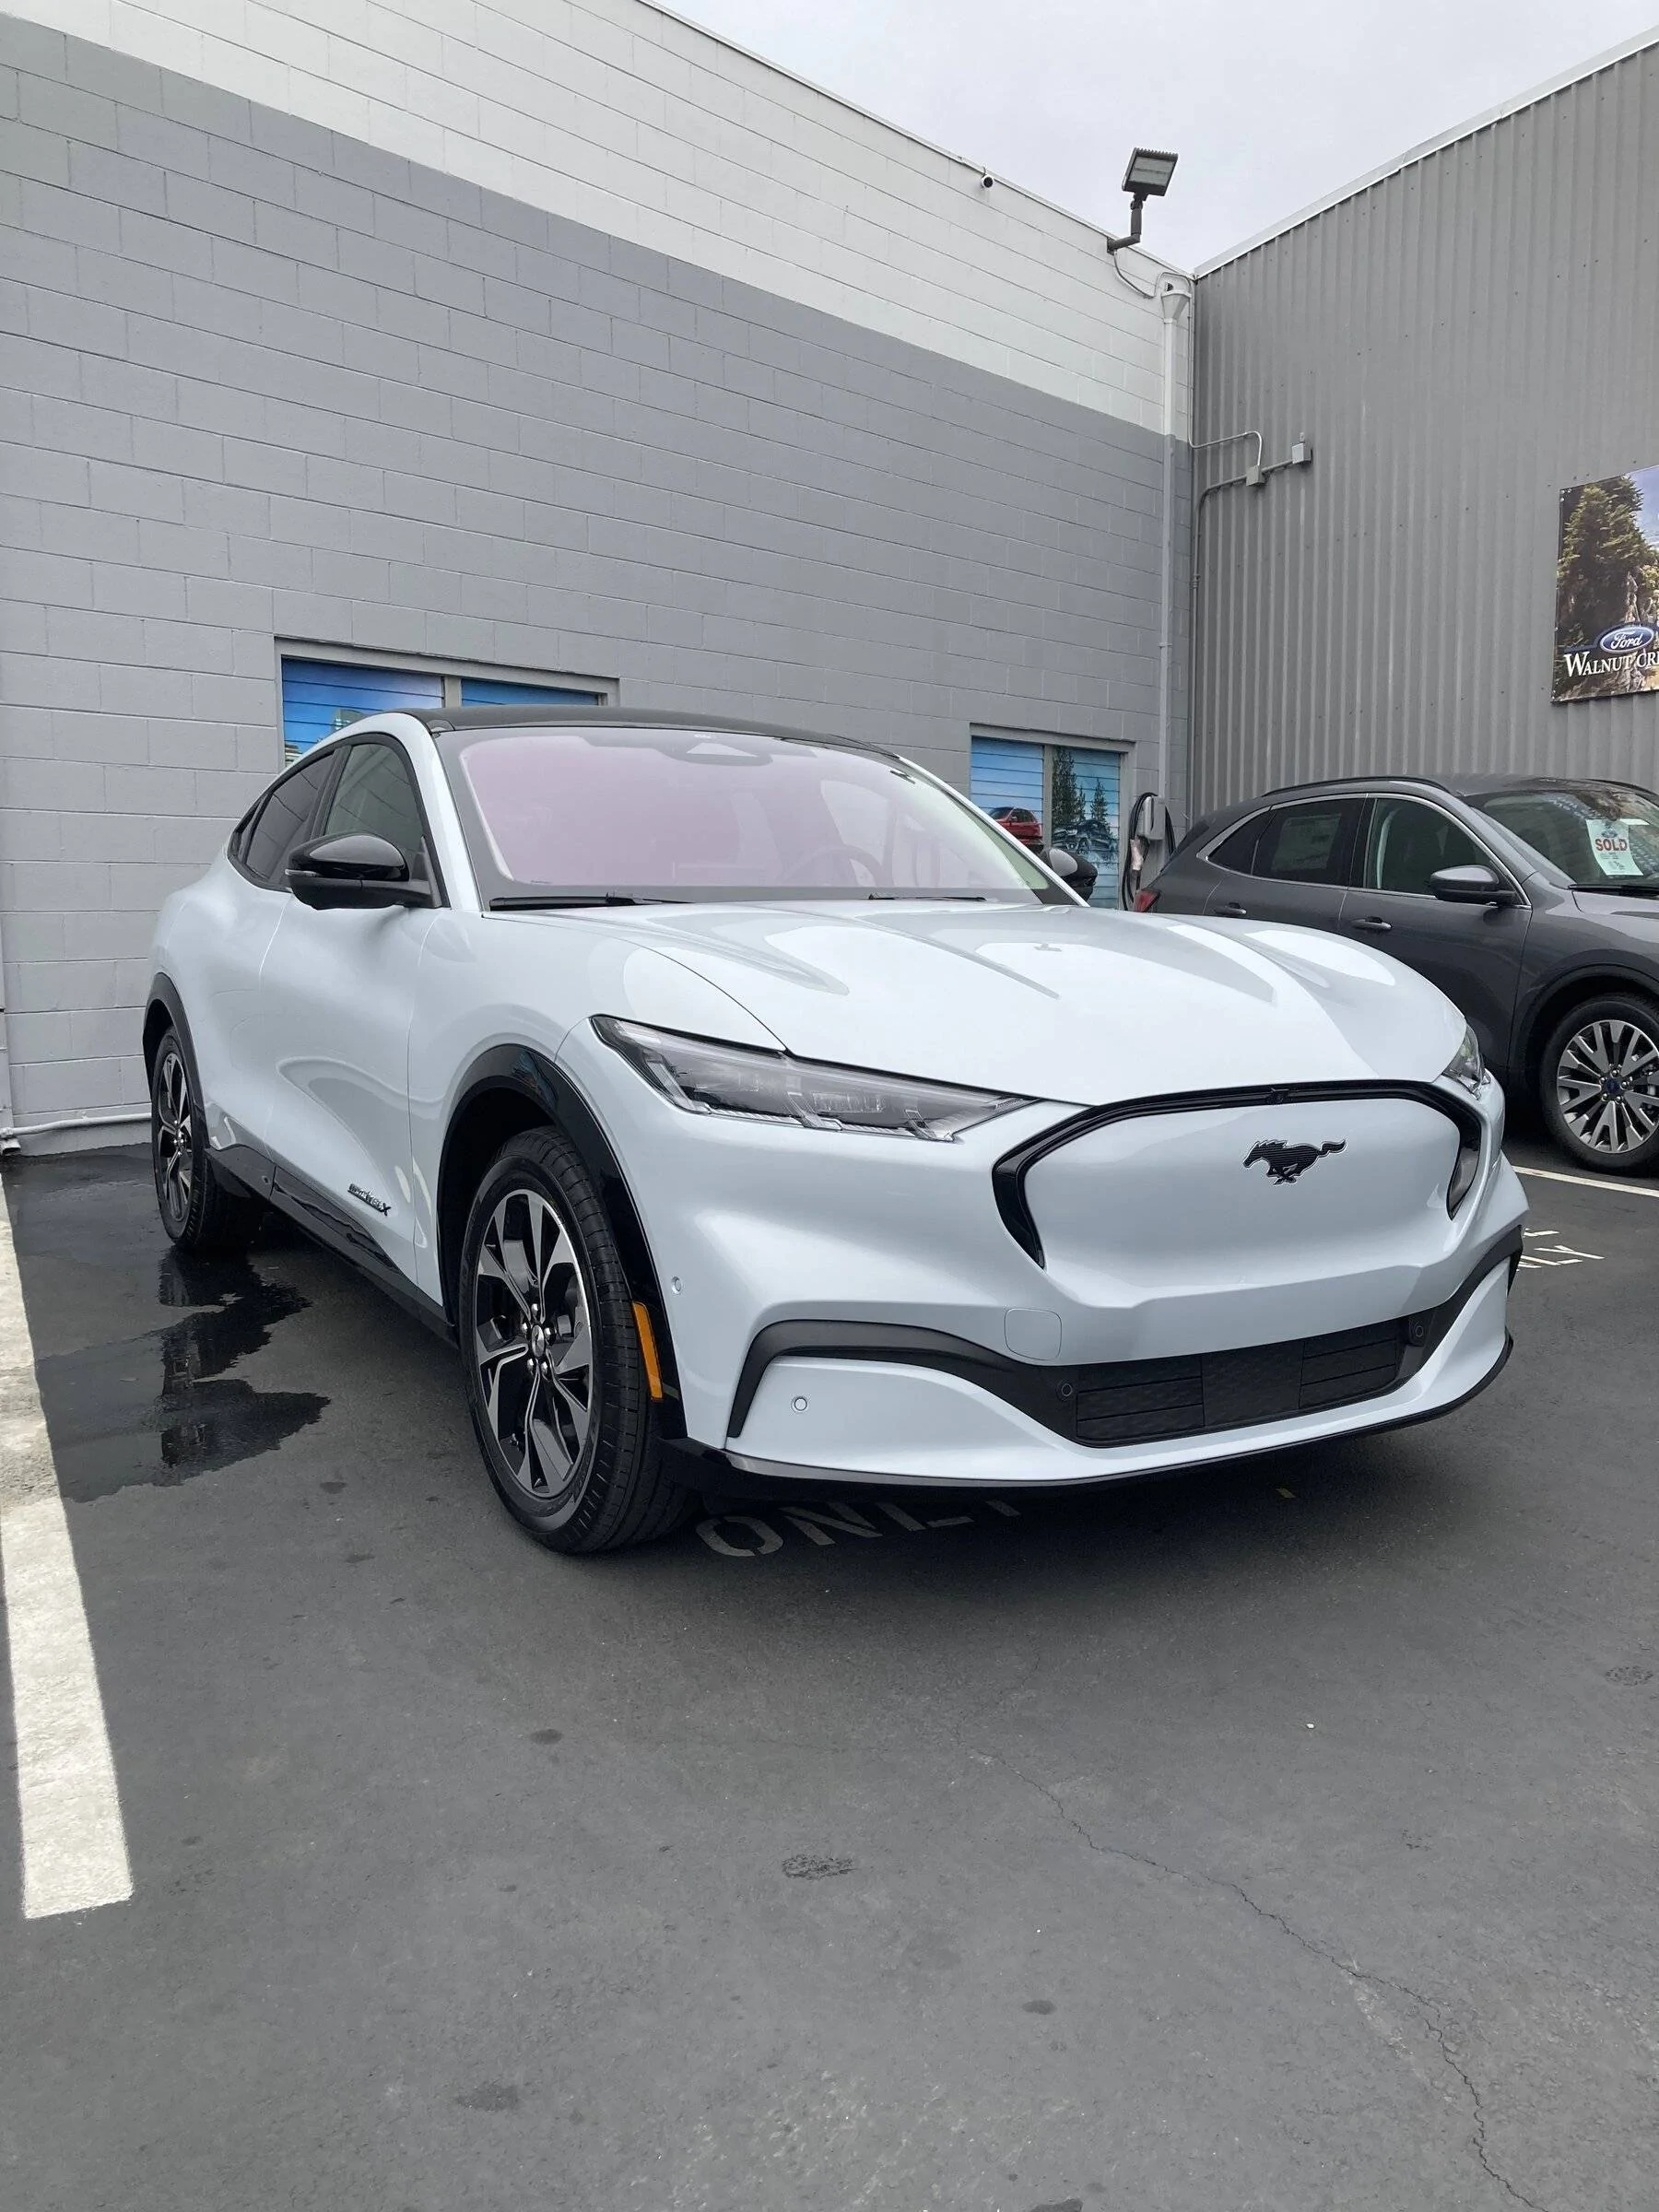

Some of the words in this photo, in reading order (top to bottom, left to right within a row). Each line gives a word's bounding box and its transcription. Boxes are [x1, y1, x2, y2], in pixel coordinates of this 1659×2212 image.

[1610, 630, 1643, 650] Ford
[1563, 651, 1634, 677] WALNUT
[1595, 838, 1628, 851] SOLD
